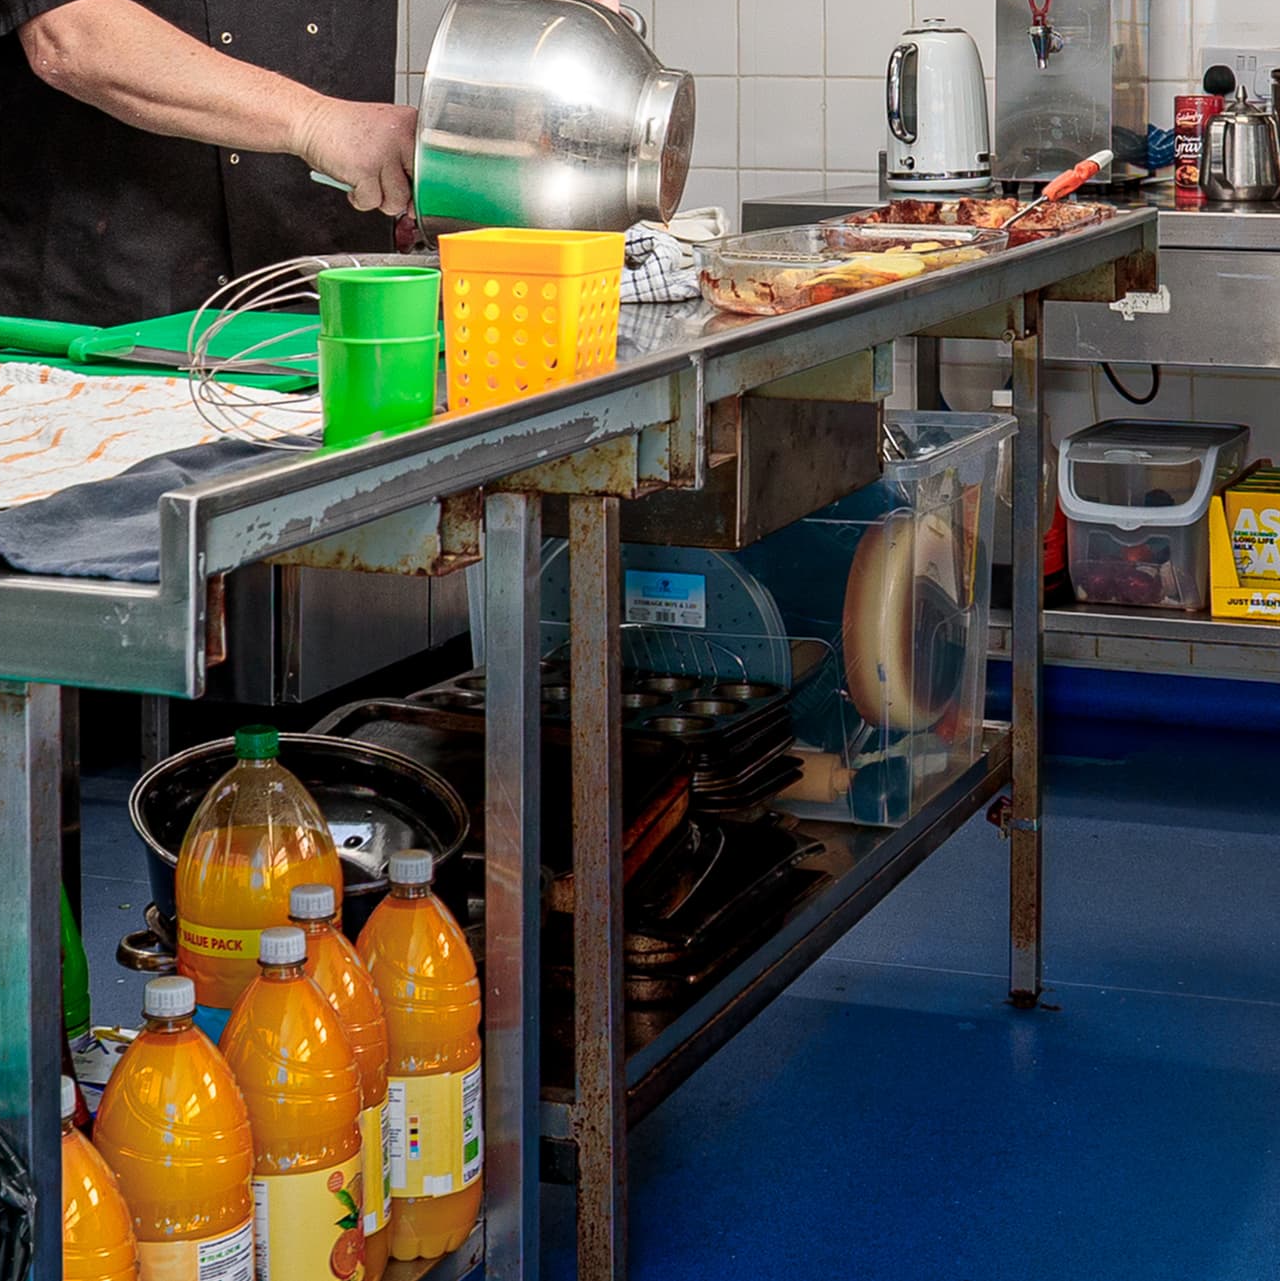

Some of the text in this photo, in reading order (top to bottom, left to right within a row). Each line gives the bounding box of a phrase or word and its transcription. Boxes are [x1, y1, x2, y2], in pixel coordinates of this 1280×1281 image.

[1175, 136, 1202, 157] Grav
[1234, 537, 1257, 545] LONG
[1227, 598, 1249, 606] JUST
[183, 931, 209, 948] VALUE
[211, 938, 243, 951] PACK
